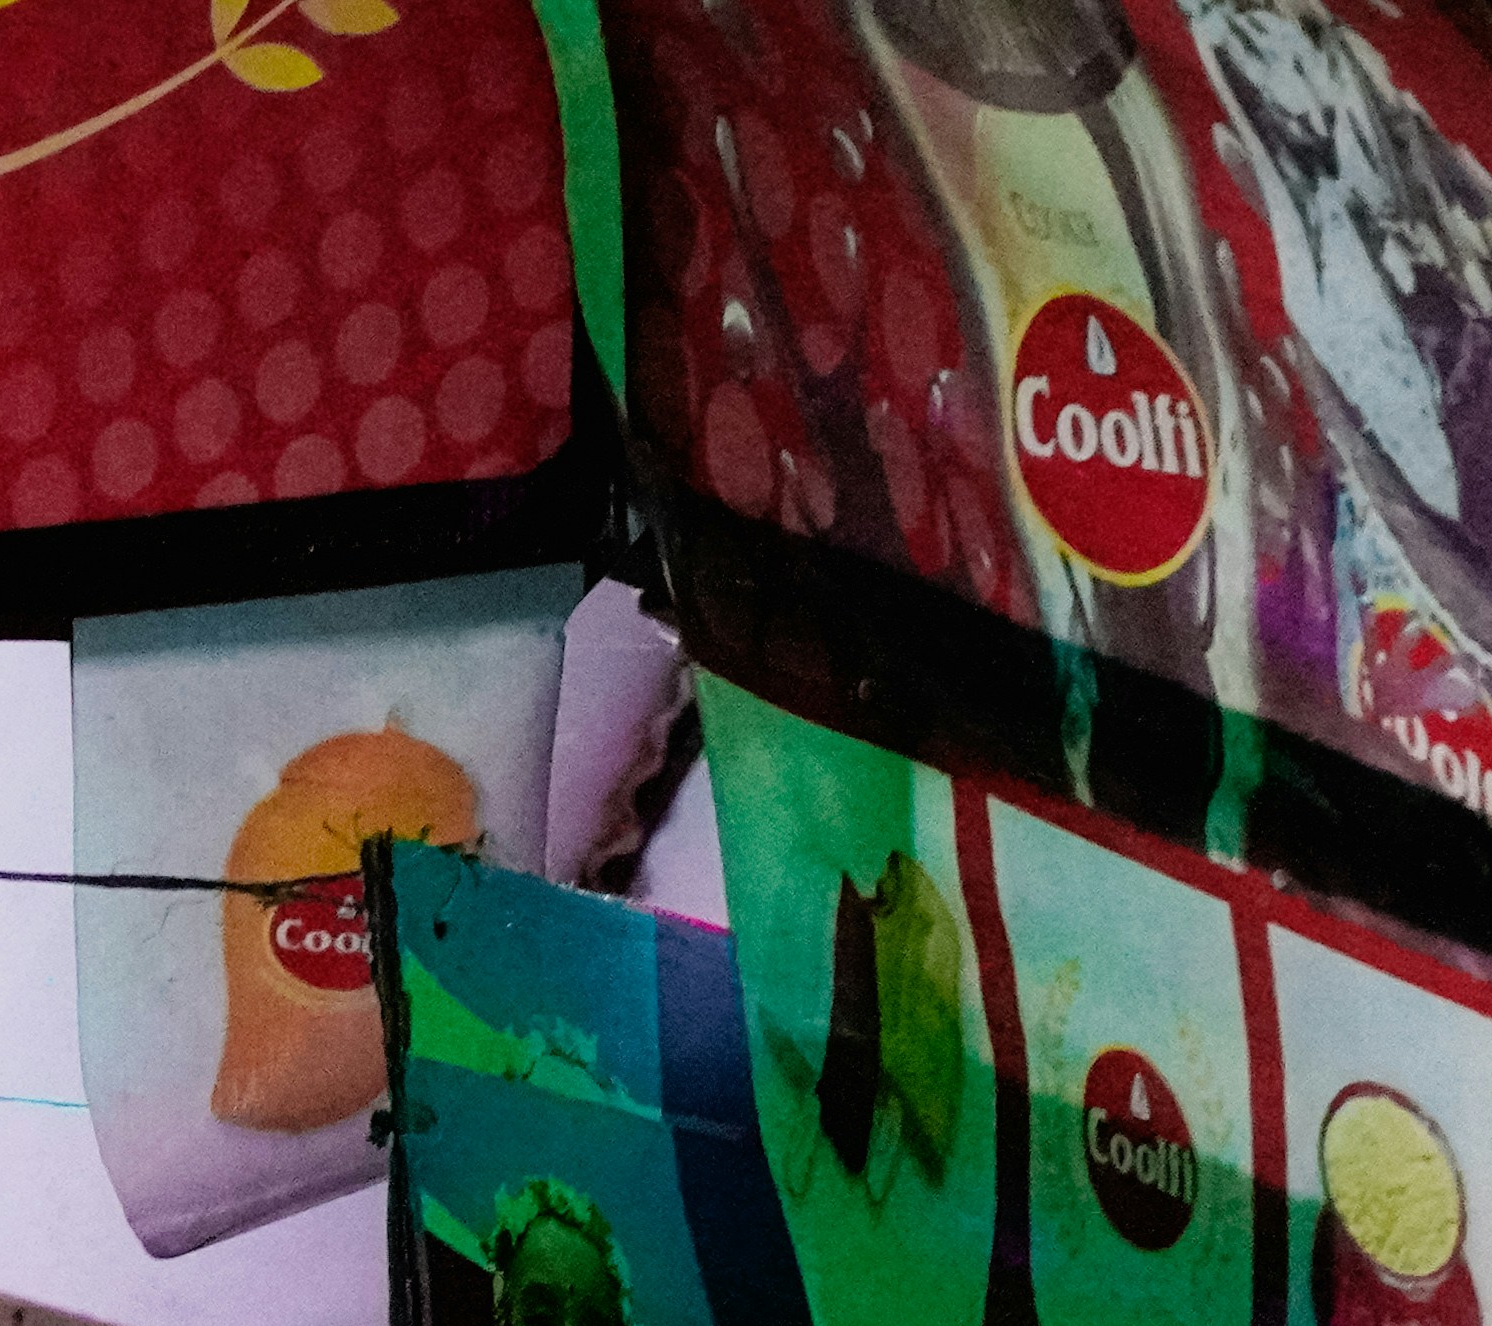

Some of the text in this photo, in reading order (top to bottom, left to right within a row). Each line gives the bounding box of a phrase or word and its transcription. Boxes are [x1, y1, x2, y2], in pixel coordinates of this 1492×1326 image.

[1018, 375, 1207, 480] Coolfi
[276, 918, 373, 963] Coo
[1088, 1107, 1194, 1203] Coolfi
